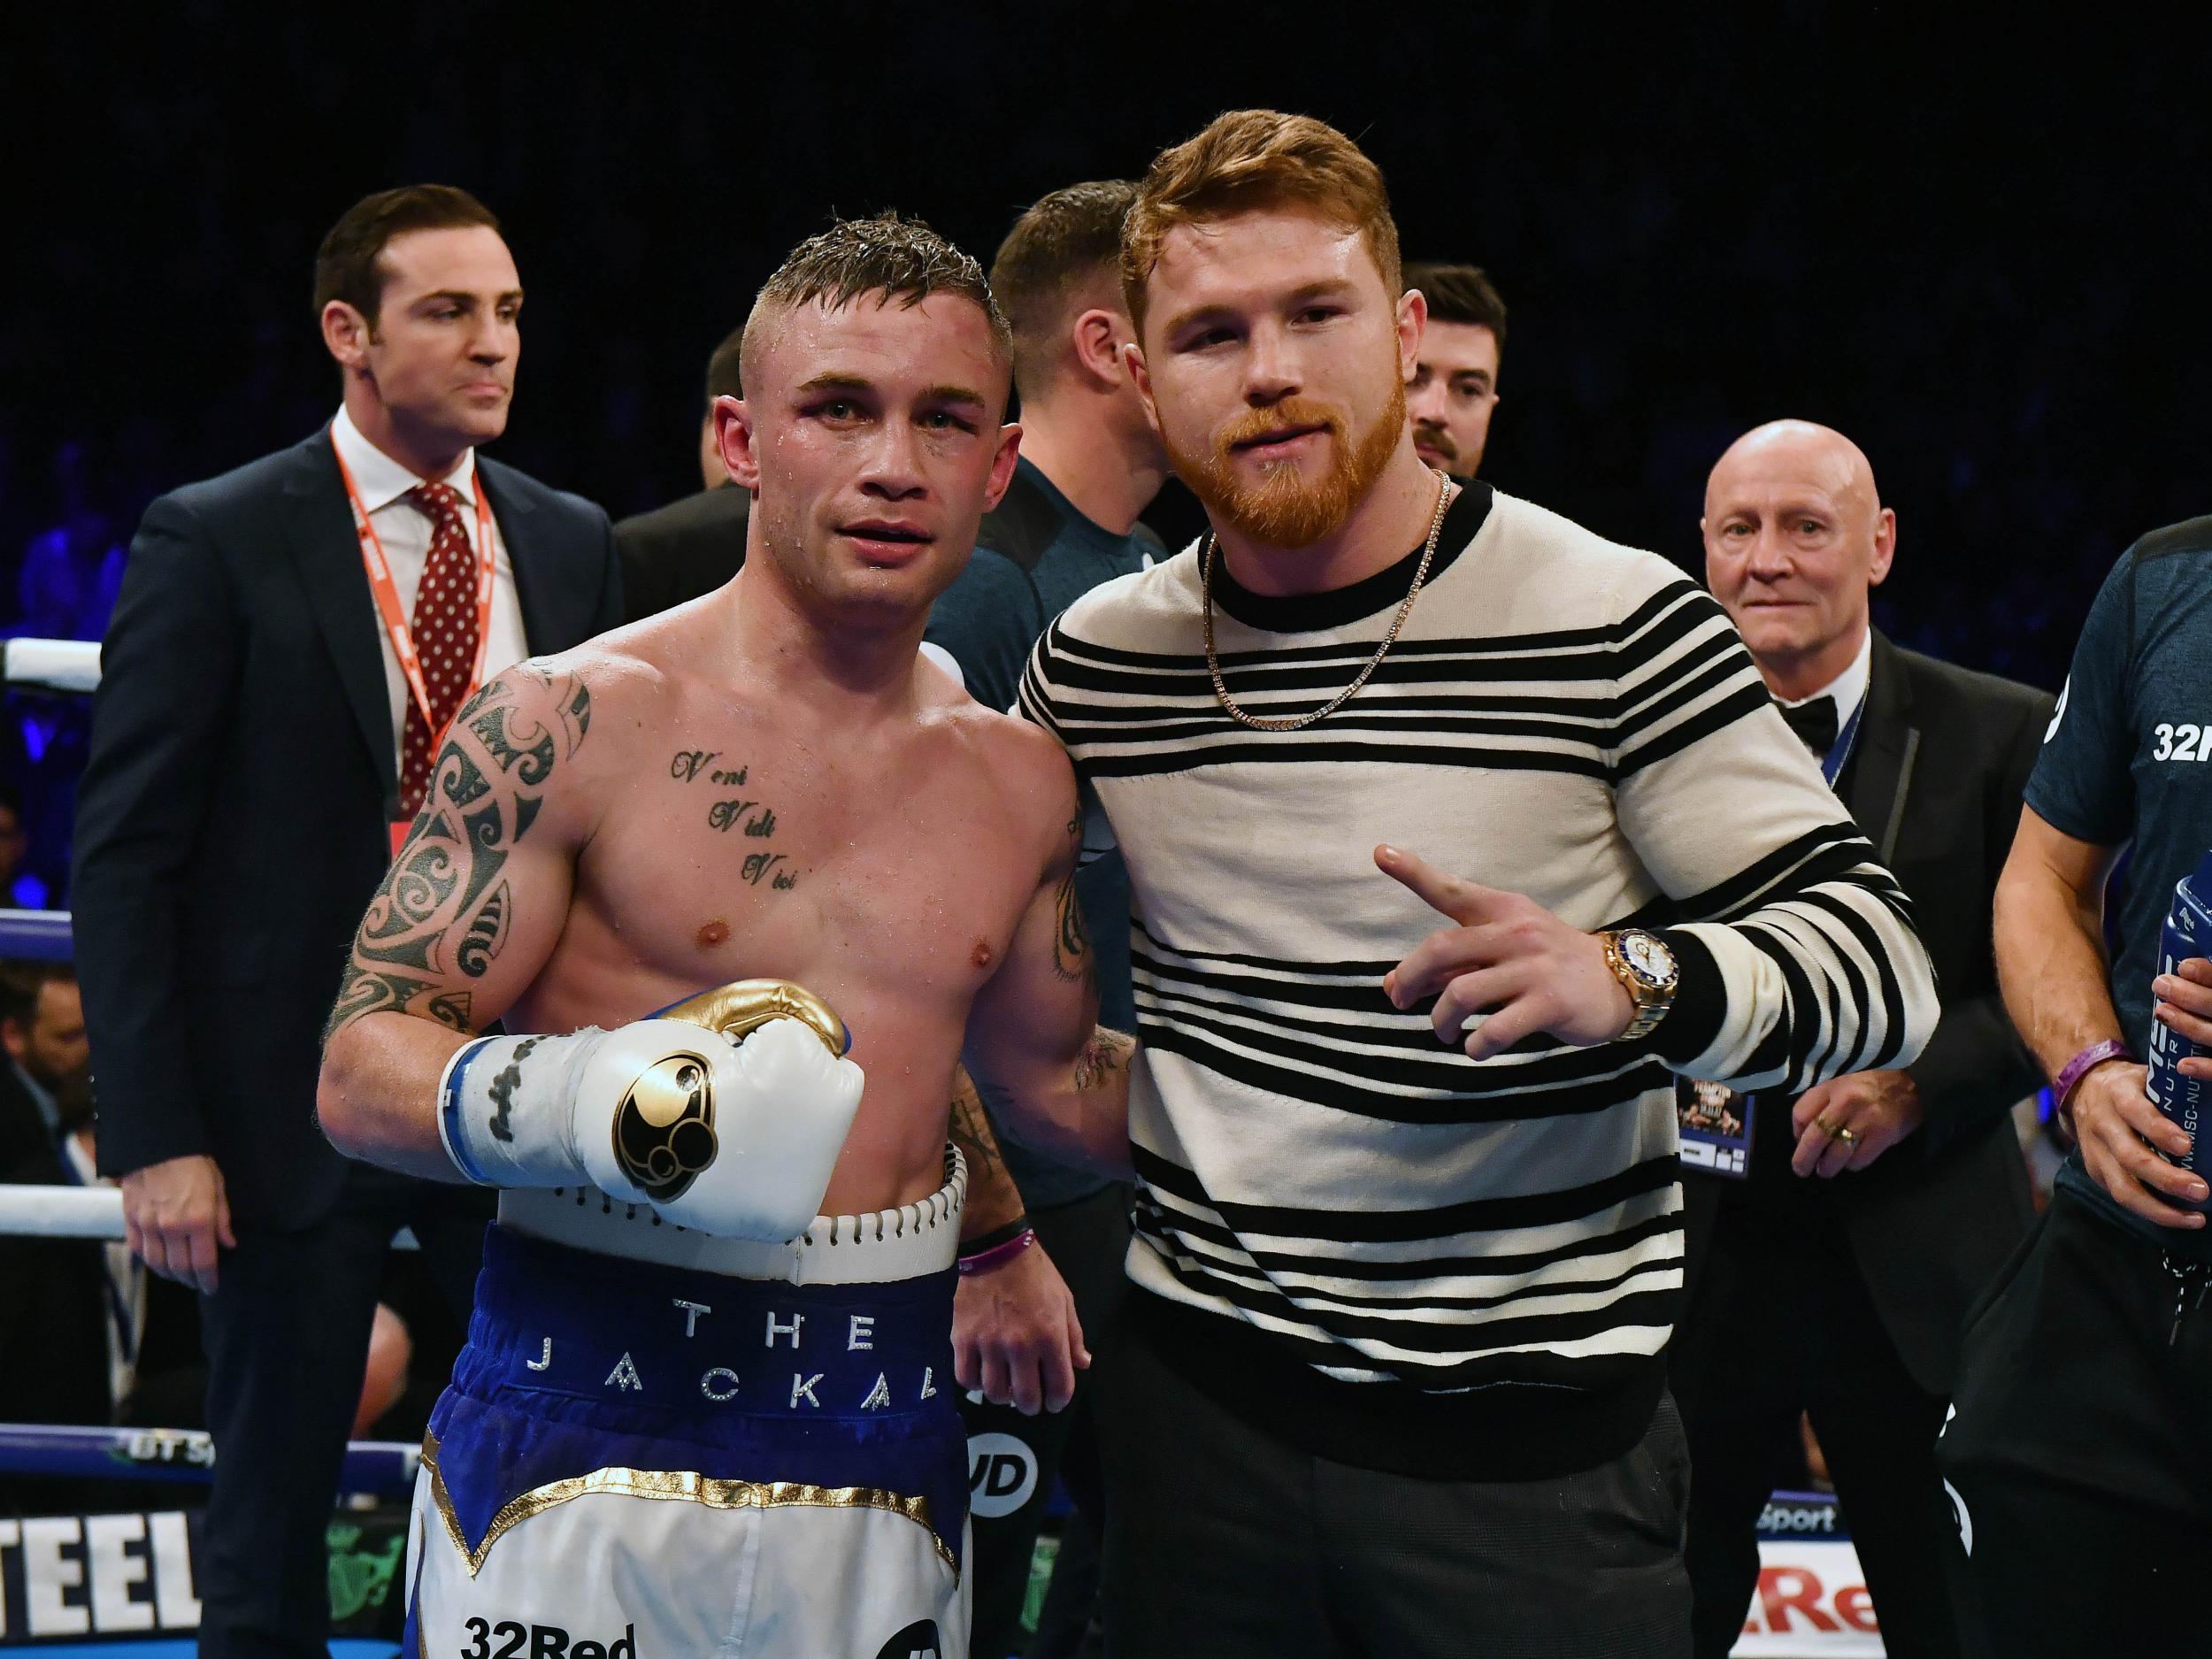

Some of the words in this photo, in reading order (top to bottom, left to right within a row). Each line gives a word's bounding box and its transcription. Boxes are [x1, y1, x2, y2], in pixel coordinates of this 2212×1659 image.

[672, 1298, 875, 1351] THE
[526, 1337, 937, 1412] JACKAL
[970, 1454, 1027, 1496] JD
[460, 1617, 637, 1659] 32Red
